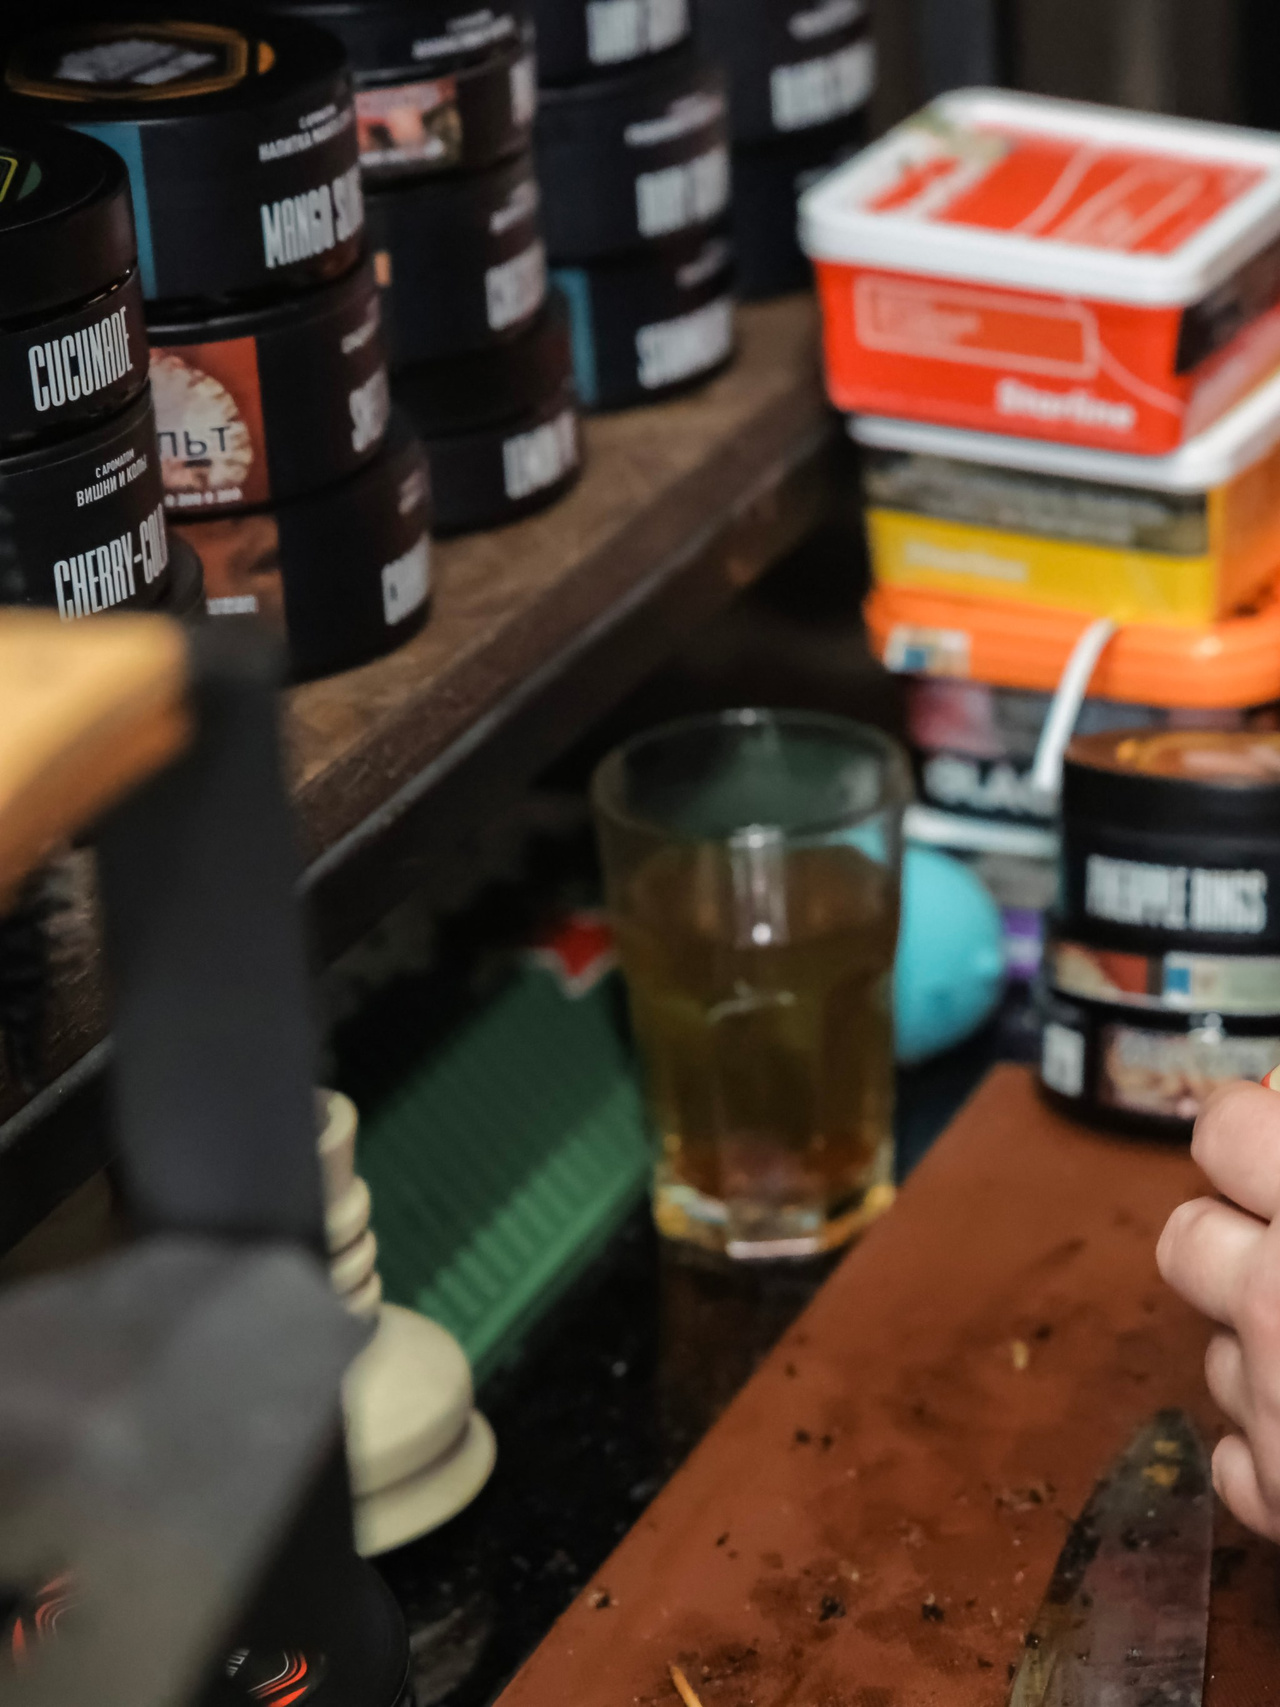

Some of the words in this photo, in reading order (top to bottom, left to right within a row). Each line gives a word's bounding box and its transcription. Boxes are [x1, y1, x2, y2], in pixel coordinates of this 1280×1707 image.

[28, 305, 133, 412] CUCUNADE
[76, 474, 118, 508] ВИШНИ
[118, 470, 126, 488] И
